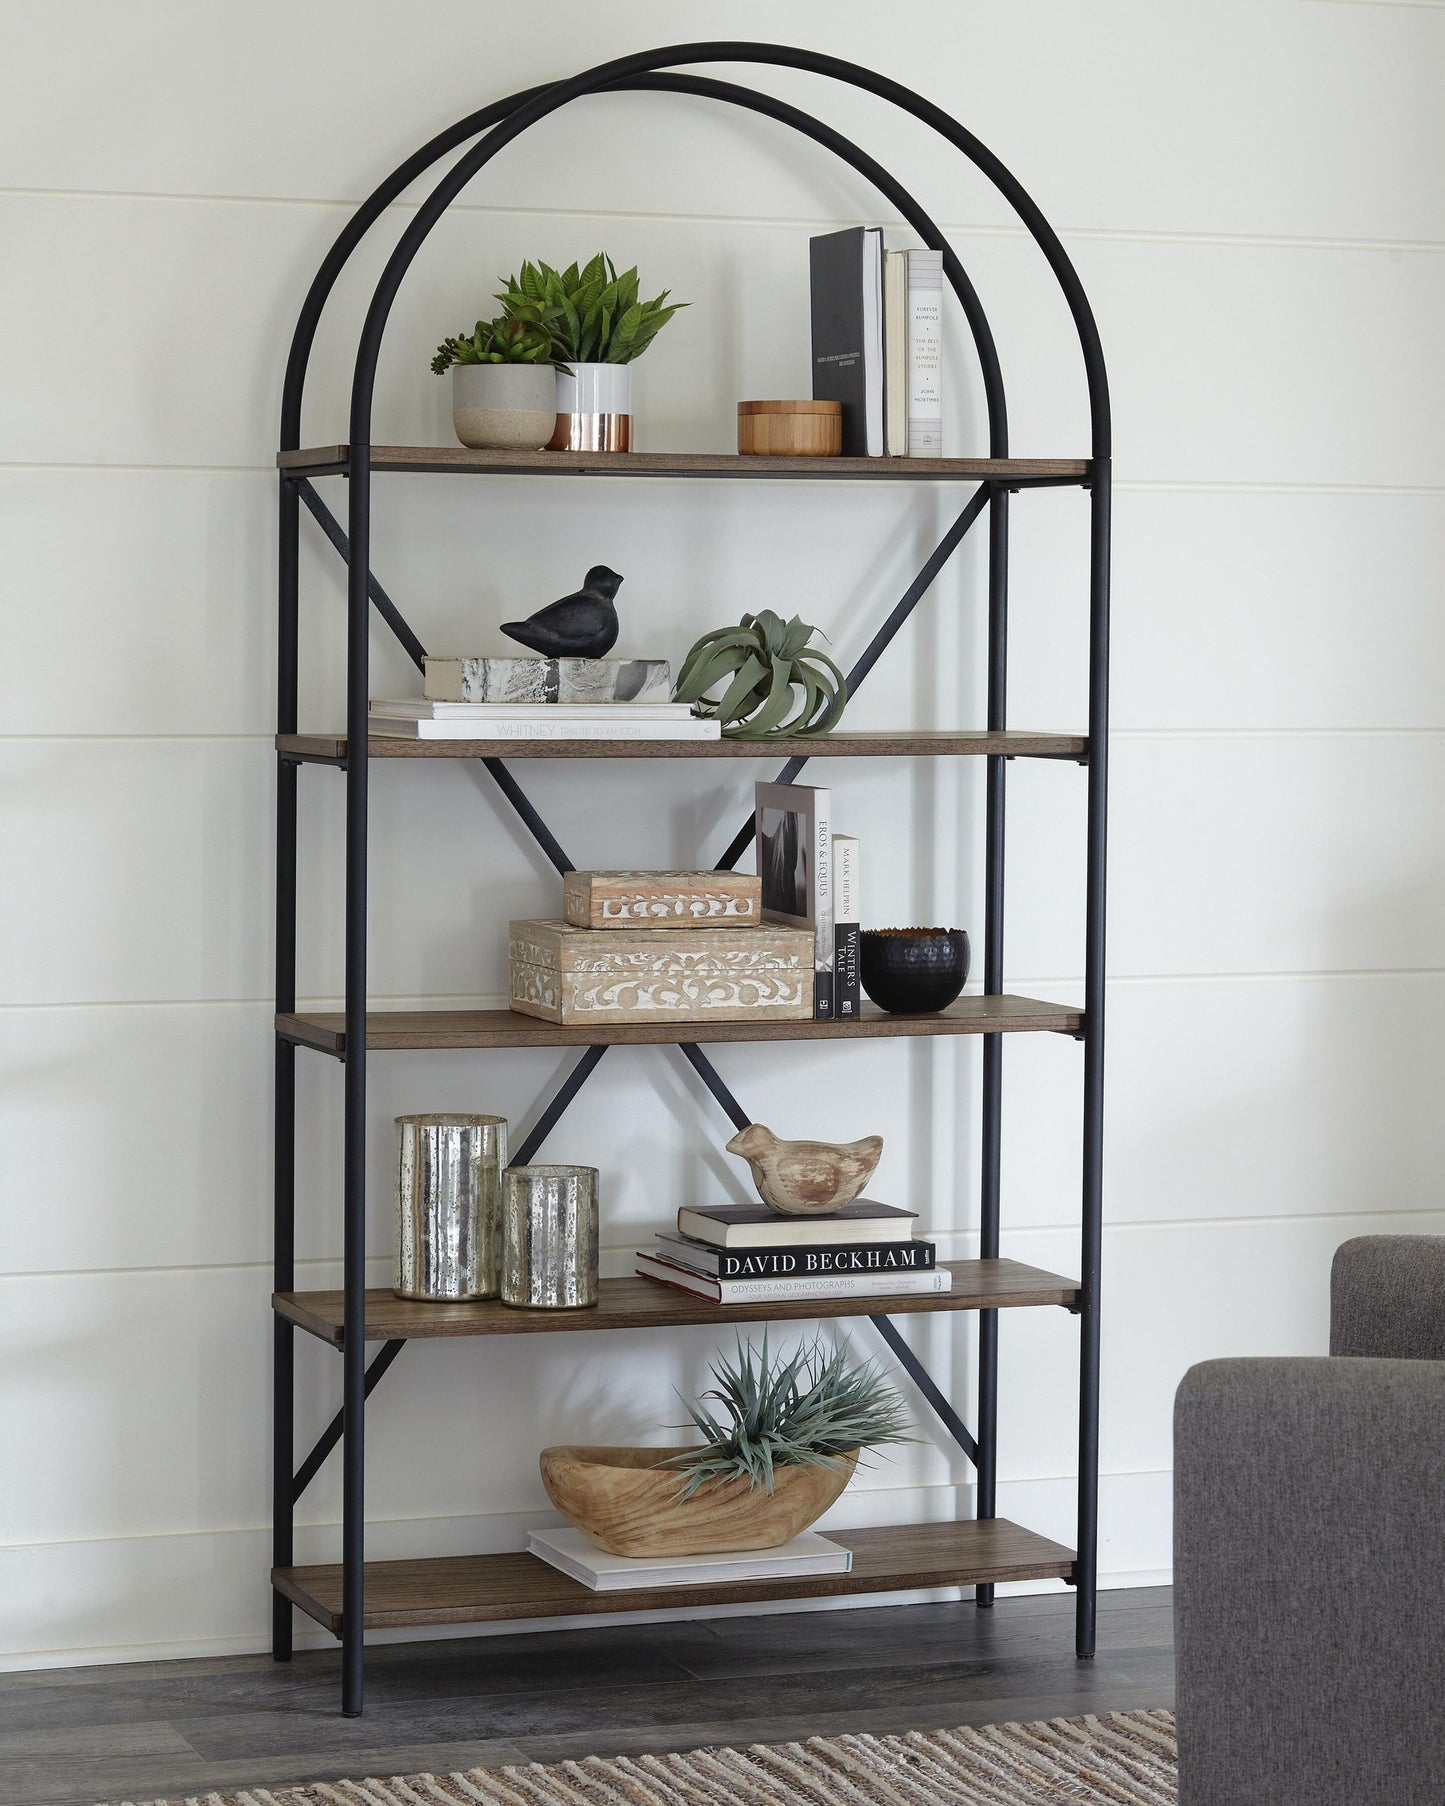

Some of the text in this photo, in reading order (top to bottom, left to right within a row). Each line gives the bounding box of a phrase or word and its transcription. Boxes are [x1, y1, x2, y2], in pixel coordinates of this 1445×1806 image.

[496, 724, 640, 736] WHITNEY TRIBUTE TO AN ICON
[817, 821, 828, 897] EROS & EQUUS
[838, 946, 846, 972] TALE
[847, 931, 857, 987] WINTER'S
[725, 1254, 796, 1275] DAVID
[806, 1249, 917, 1271] BECKHAM
[731, 1280, 856, 1294] ODYSSEYS AND PHOTOGRAPHS
